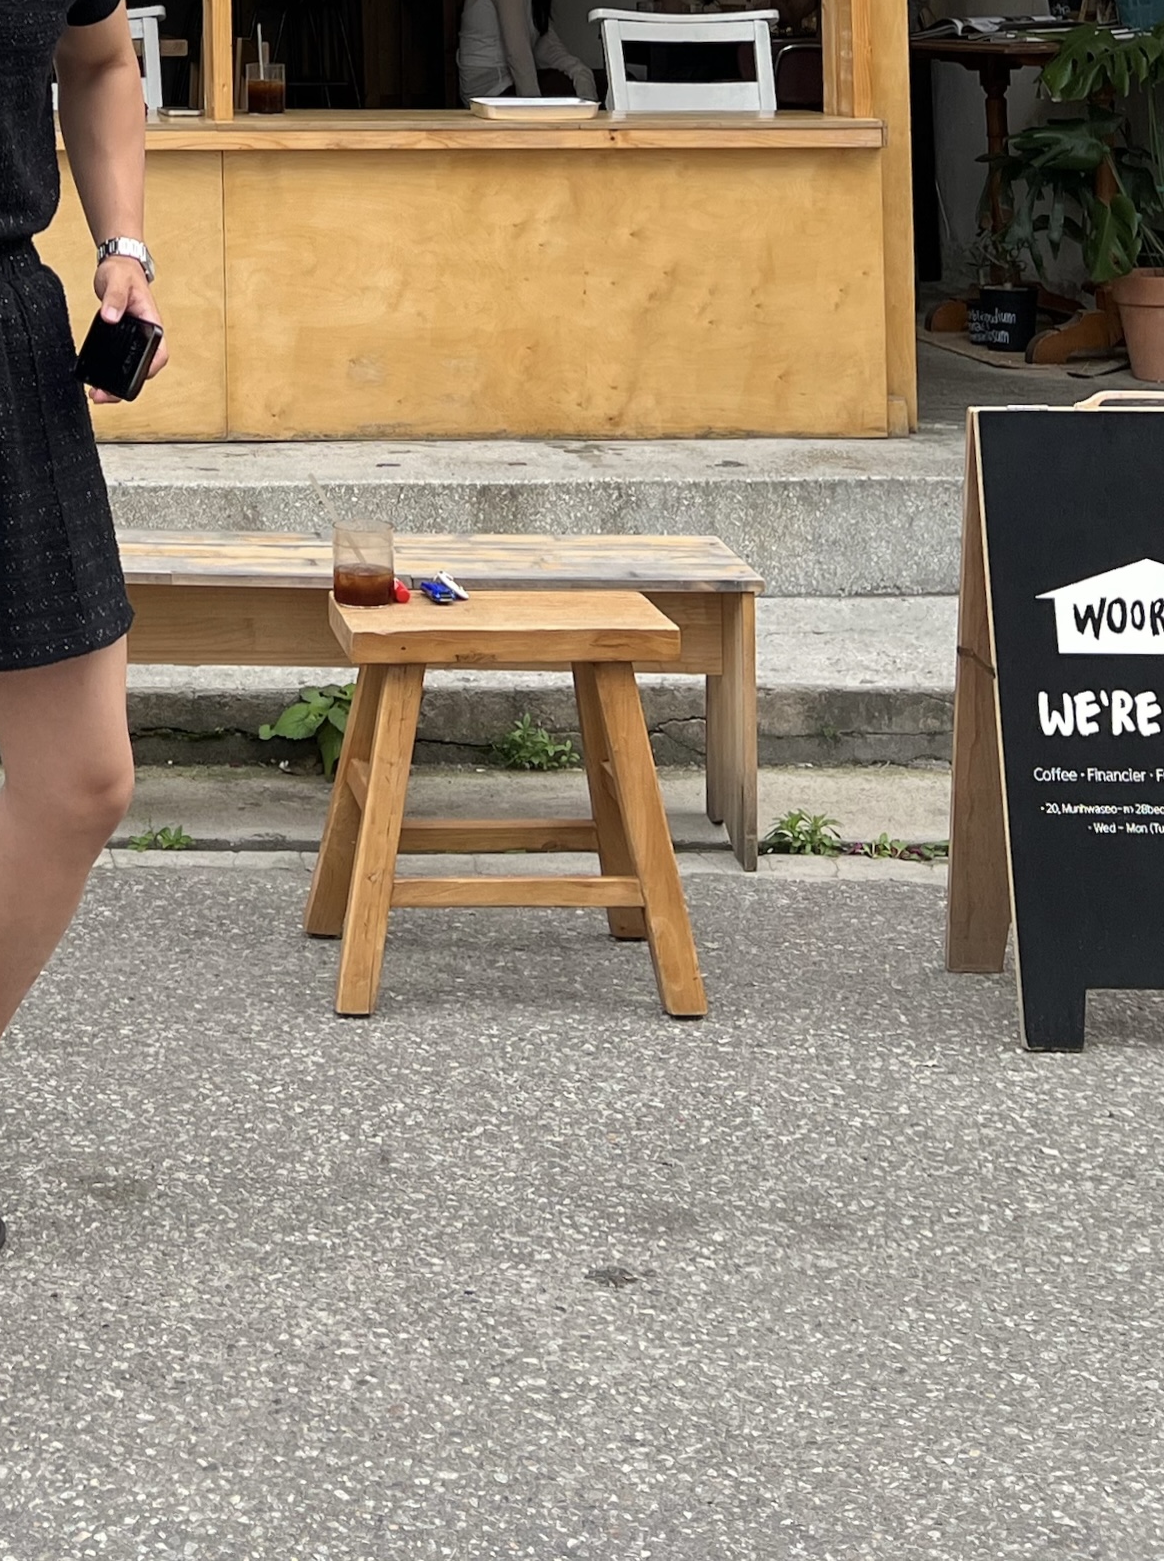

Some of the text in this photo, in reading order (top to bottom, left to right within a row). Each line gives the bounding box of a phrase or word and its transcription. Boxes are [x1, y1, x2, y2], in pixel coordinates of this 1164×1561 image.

[1072, 597, 1164, 640] WOOR
[1038, 690, 1162, 737] WE'RE
[1033, 767, 1078, 782] Coffee
[1086, 768, 1146, 782] Financier
[1092, 822, 1117, 834] Wed
[1125, 822, 1149, 834] Mon
